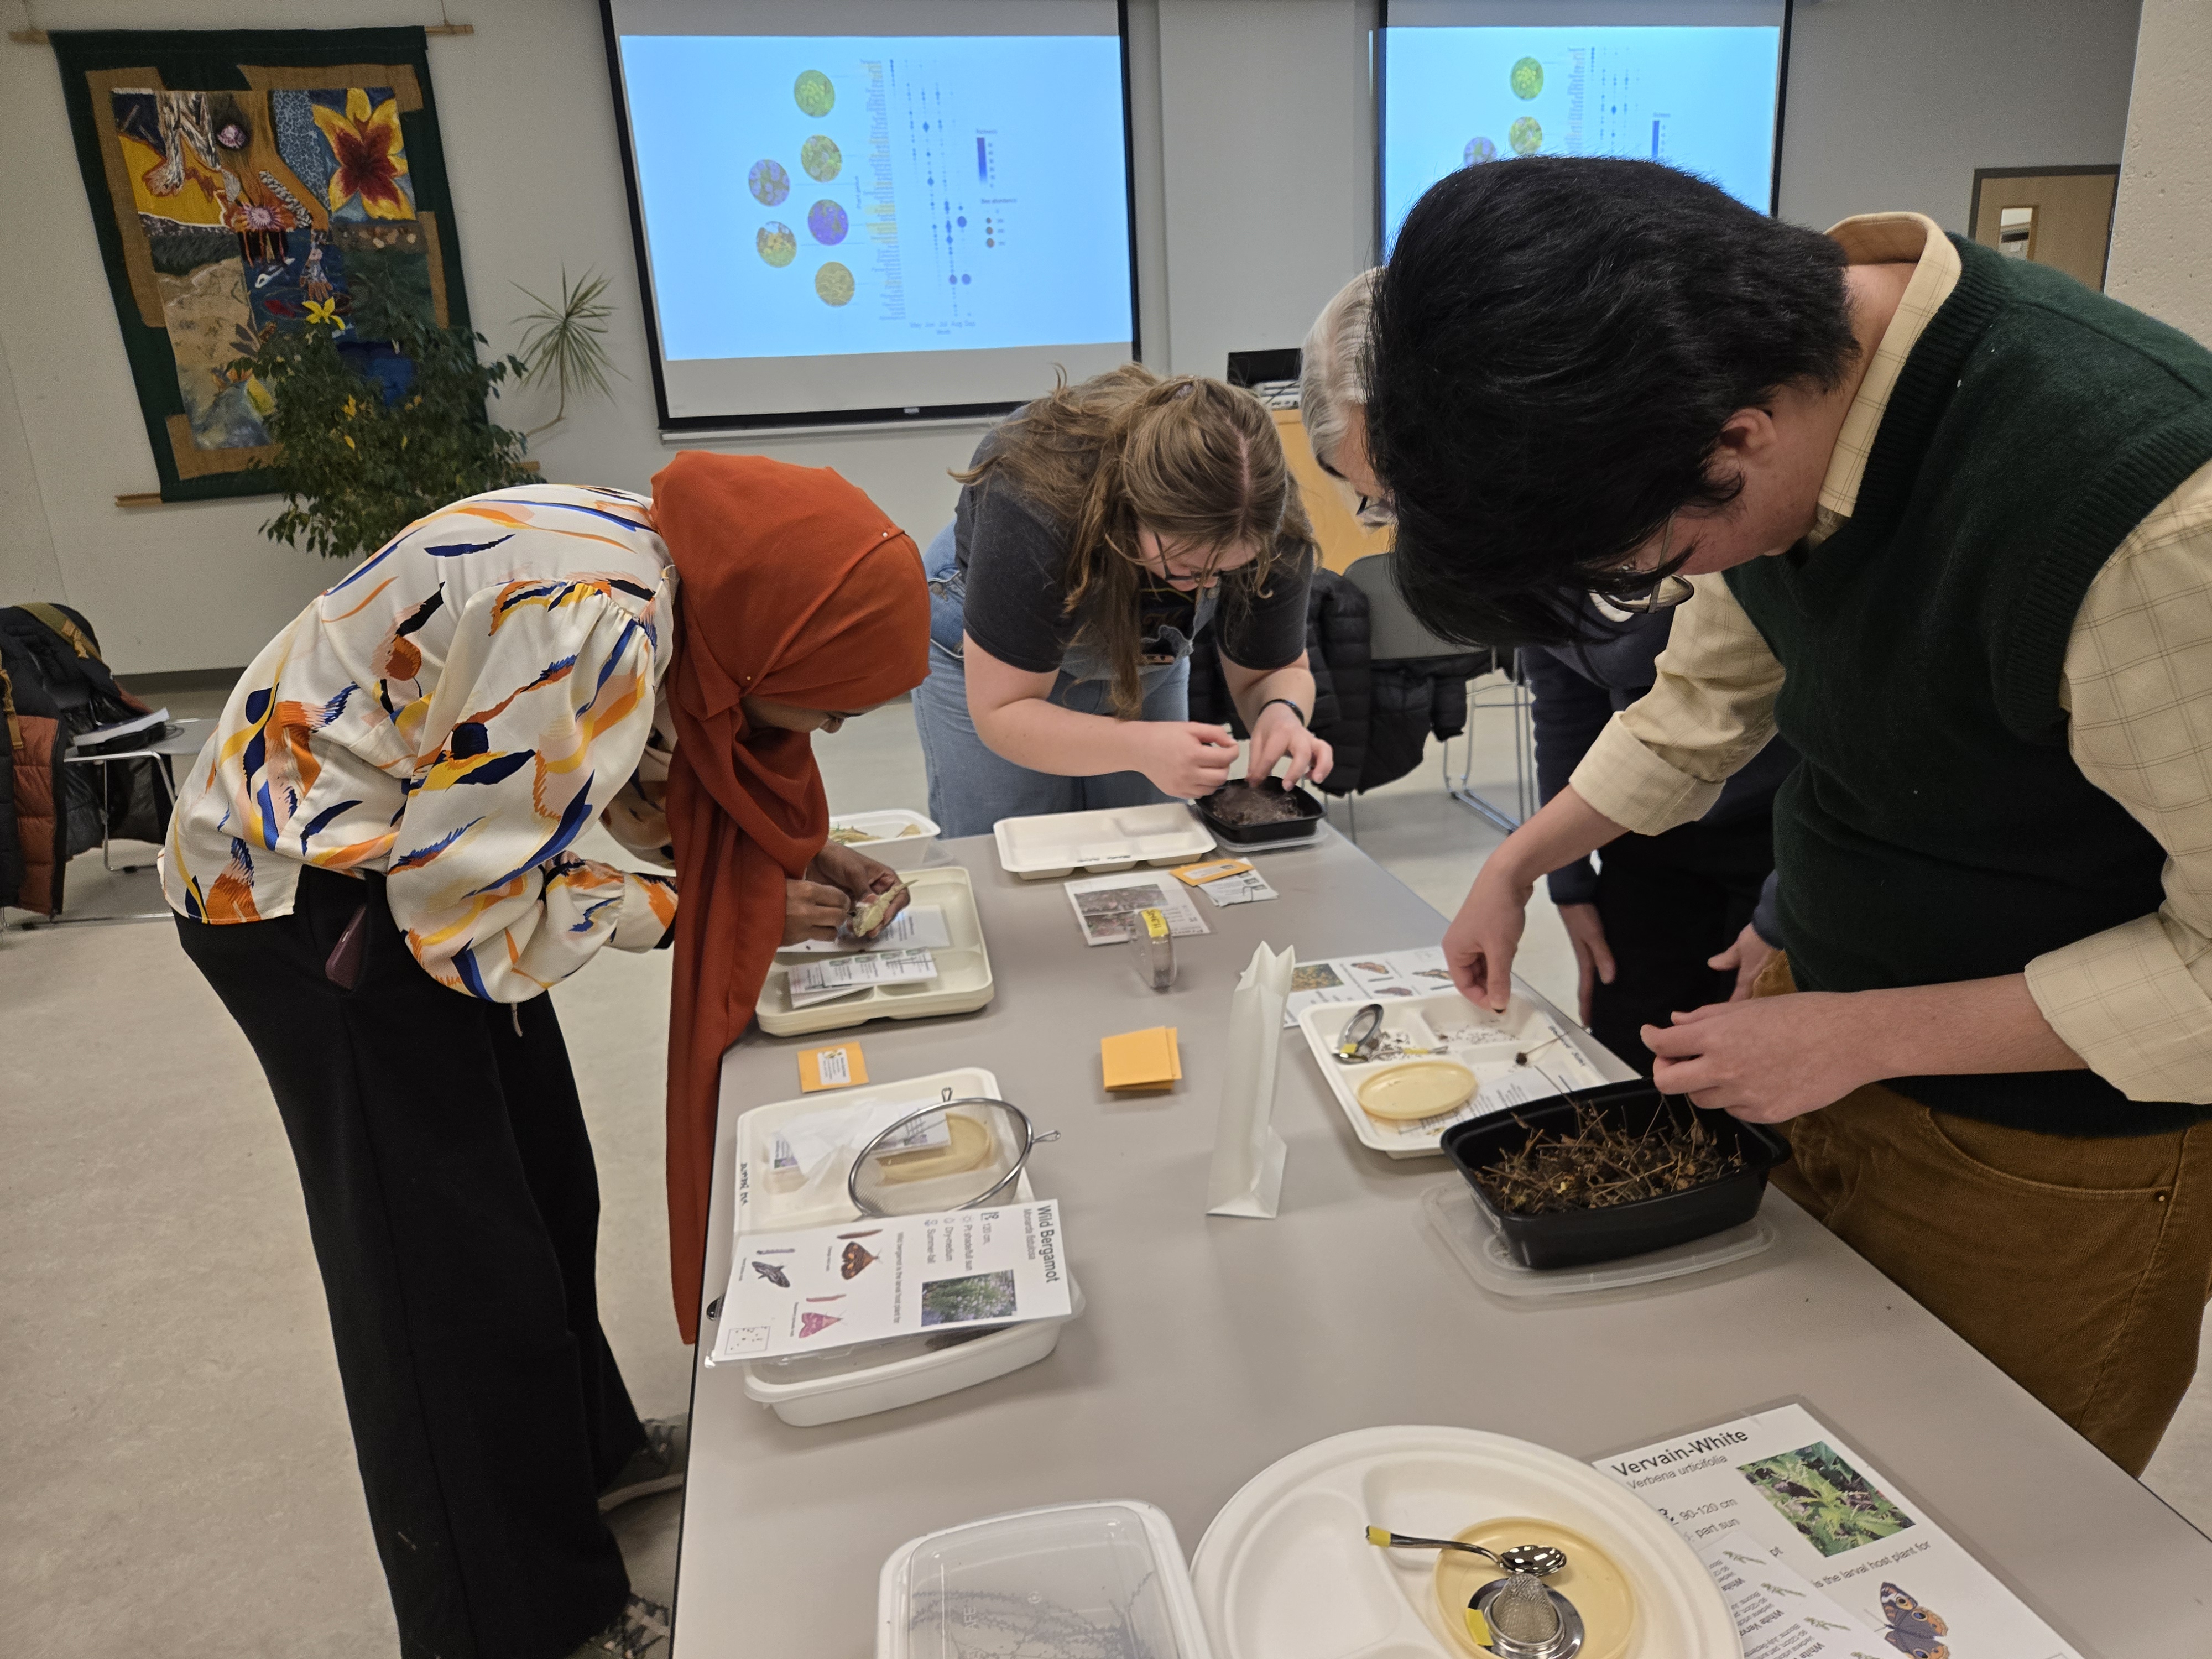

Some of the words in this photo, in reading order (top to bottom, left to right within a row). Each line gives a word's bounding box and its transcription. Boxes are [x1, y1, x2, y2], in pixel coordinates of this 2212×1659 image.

[1037, 1205, 1053, 1228] Wild
[1039, 1229, 1060, 1283] Bergamot
[1611, 1431, 1749, 1477] Vervain-White
[1627, 1468, 1676, 1490] Verbena
[1677, 1454, 1728, 1475] urticifolia
[1679, 1502, 1719, 1521] 90-120
[1720, 1498, 1738, 1509] cm
[1695, 1522, 1719, 1538] part
[1718, 1517, 1740, 1530] sun
[1811, 1579, 1824, 1589] is
[1823, 1573, 1841, 1585] the
[1839, 1563, 1870, 1579] larval
[1867, 1556, 1893, 1570] host
[1891, 1546, 1918, 1563] plant
[1915, 1540, 1932, 1553] for
[1759, 1609, 1785, 1624] White
[1739, 1623, 1763, 1637] Verva
[1799, 1642, 1825, 1659] White
